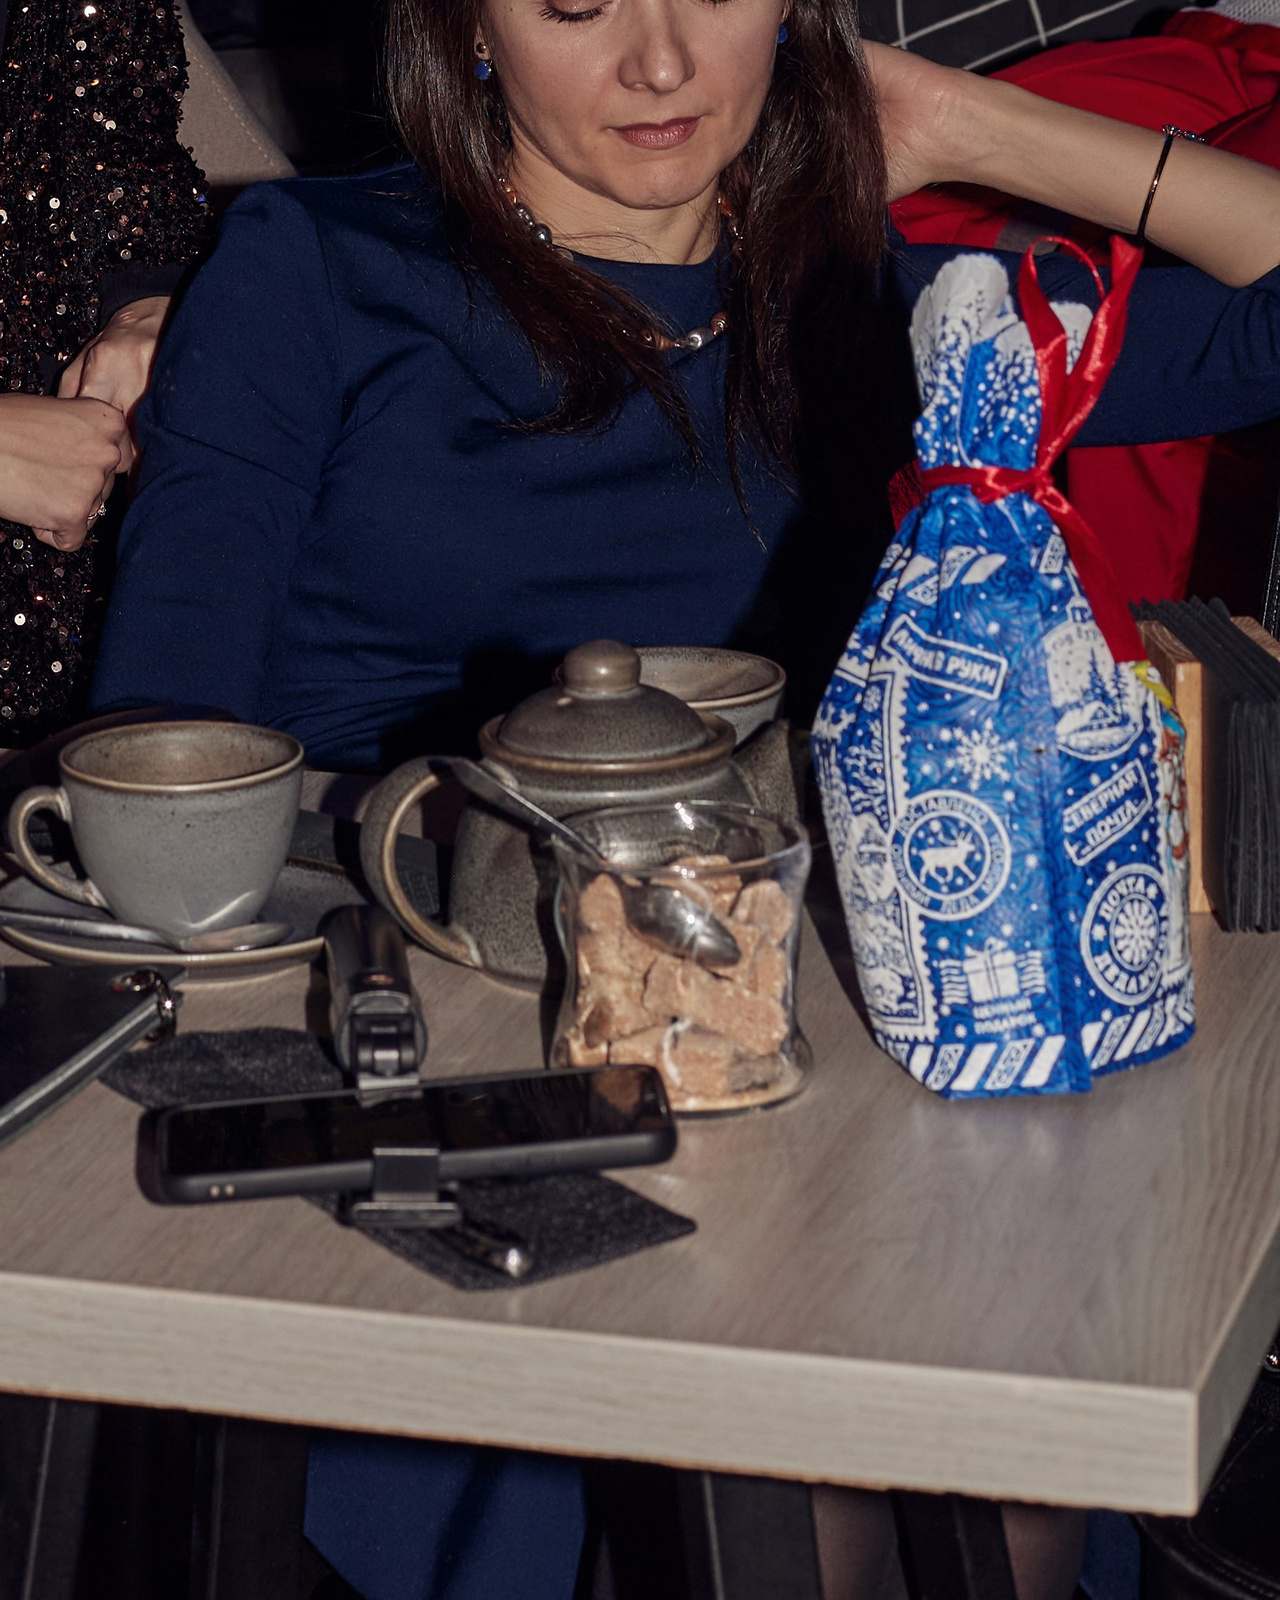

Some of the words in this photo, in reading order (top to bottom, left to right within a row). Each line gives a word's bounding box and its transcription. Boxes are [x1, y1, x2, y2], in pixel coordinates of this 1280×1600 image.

[945, 655, 998, 687] РУКИ
[1063, 768, 1139, 833] СЕВЕРНАЯ
[1085, 799, 1138, 846] ПОЧТА
[1098, 876, 1146, 922] ПОЧТА
